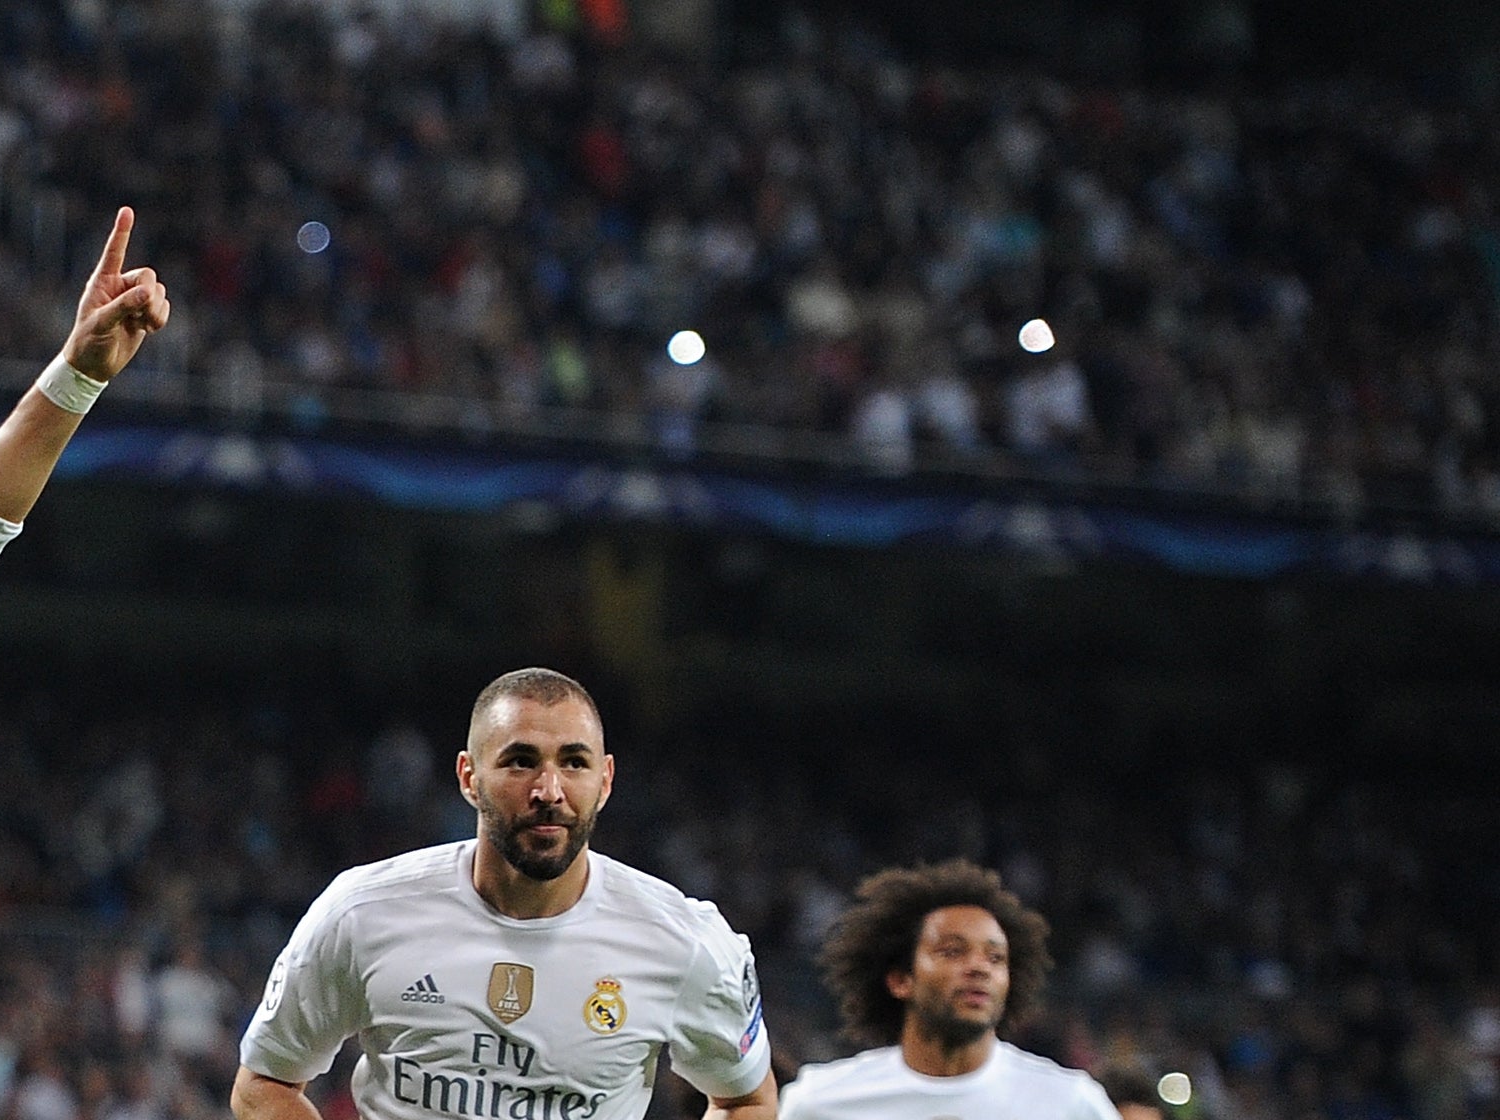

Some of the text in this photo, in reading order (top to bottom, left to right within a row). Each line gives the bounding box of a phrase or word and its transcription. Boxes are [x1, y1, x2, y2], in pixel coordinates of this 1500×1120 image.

[401, 991, 445, 1004] adidas
[498, 1000, 520, 1010] FIFA
[472, 1033, 536, 1077] Fly
